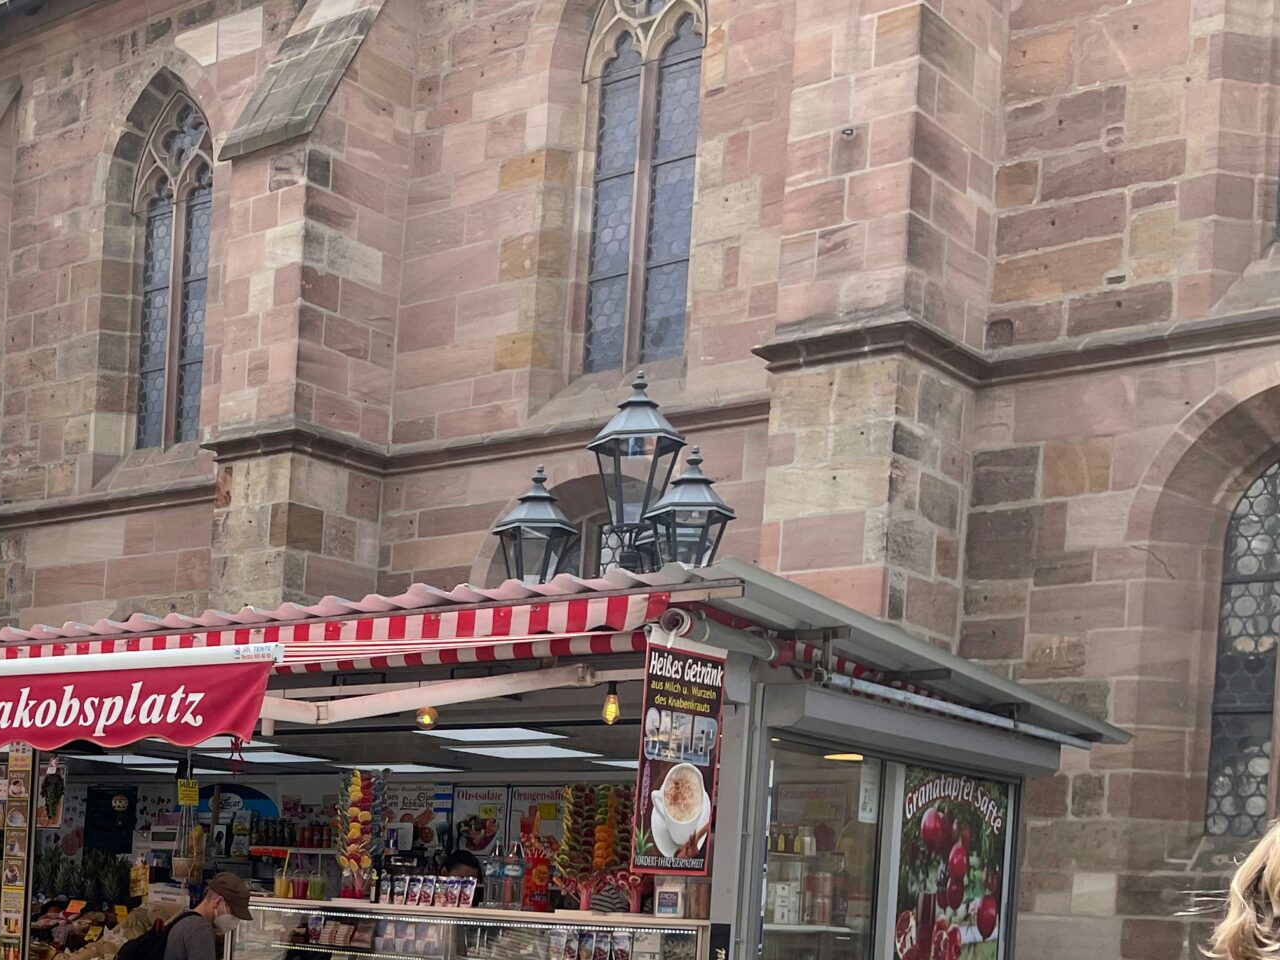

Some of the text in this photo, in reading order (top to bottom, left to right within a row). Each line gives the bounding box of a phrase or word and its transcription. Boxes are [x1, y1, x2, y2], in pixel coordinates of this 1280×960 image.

[649, 651, 723, 687] Heißes Getränk
[651, 680, 663, 689] aus
[665, 681, 681, 692] Milch
[691, 685, 717, 700] Wurzeln
[655, 694, 710, 713] des Knabenkrauts
[456, 790, 503, 801] Obstsalate
[513, 789, 563, 801] Orangensäft
[906, 776, 1002, 834] Granatapfel Säfte
